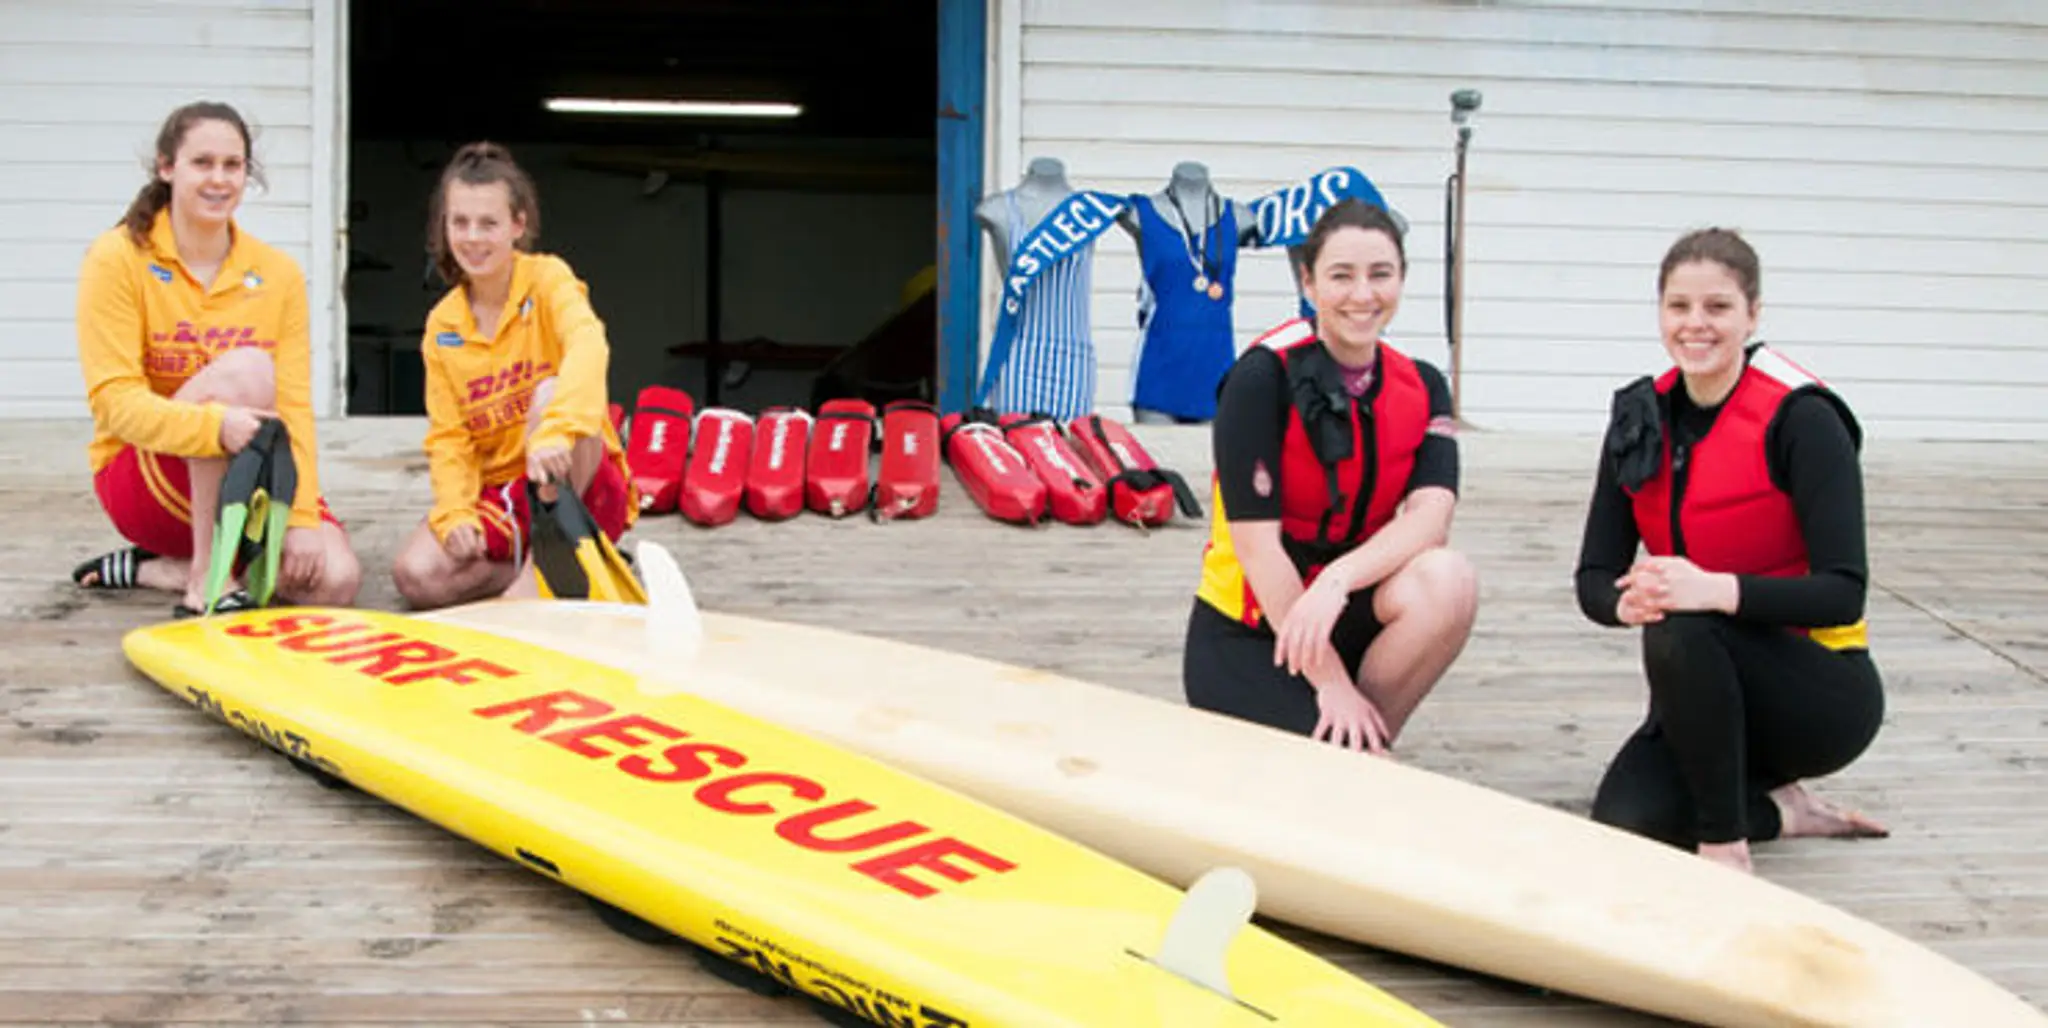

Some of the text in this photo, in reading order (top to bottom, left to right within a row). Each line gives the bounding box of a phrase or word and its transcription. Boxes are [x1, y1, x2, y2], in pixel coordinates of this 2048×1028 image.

[1256, 170, 1350, 244] ORS
[225, 613, 519, 687] SURF
[475, 690, 1017, 899] RESCUE
